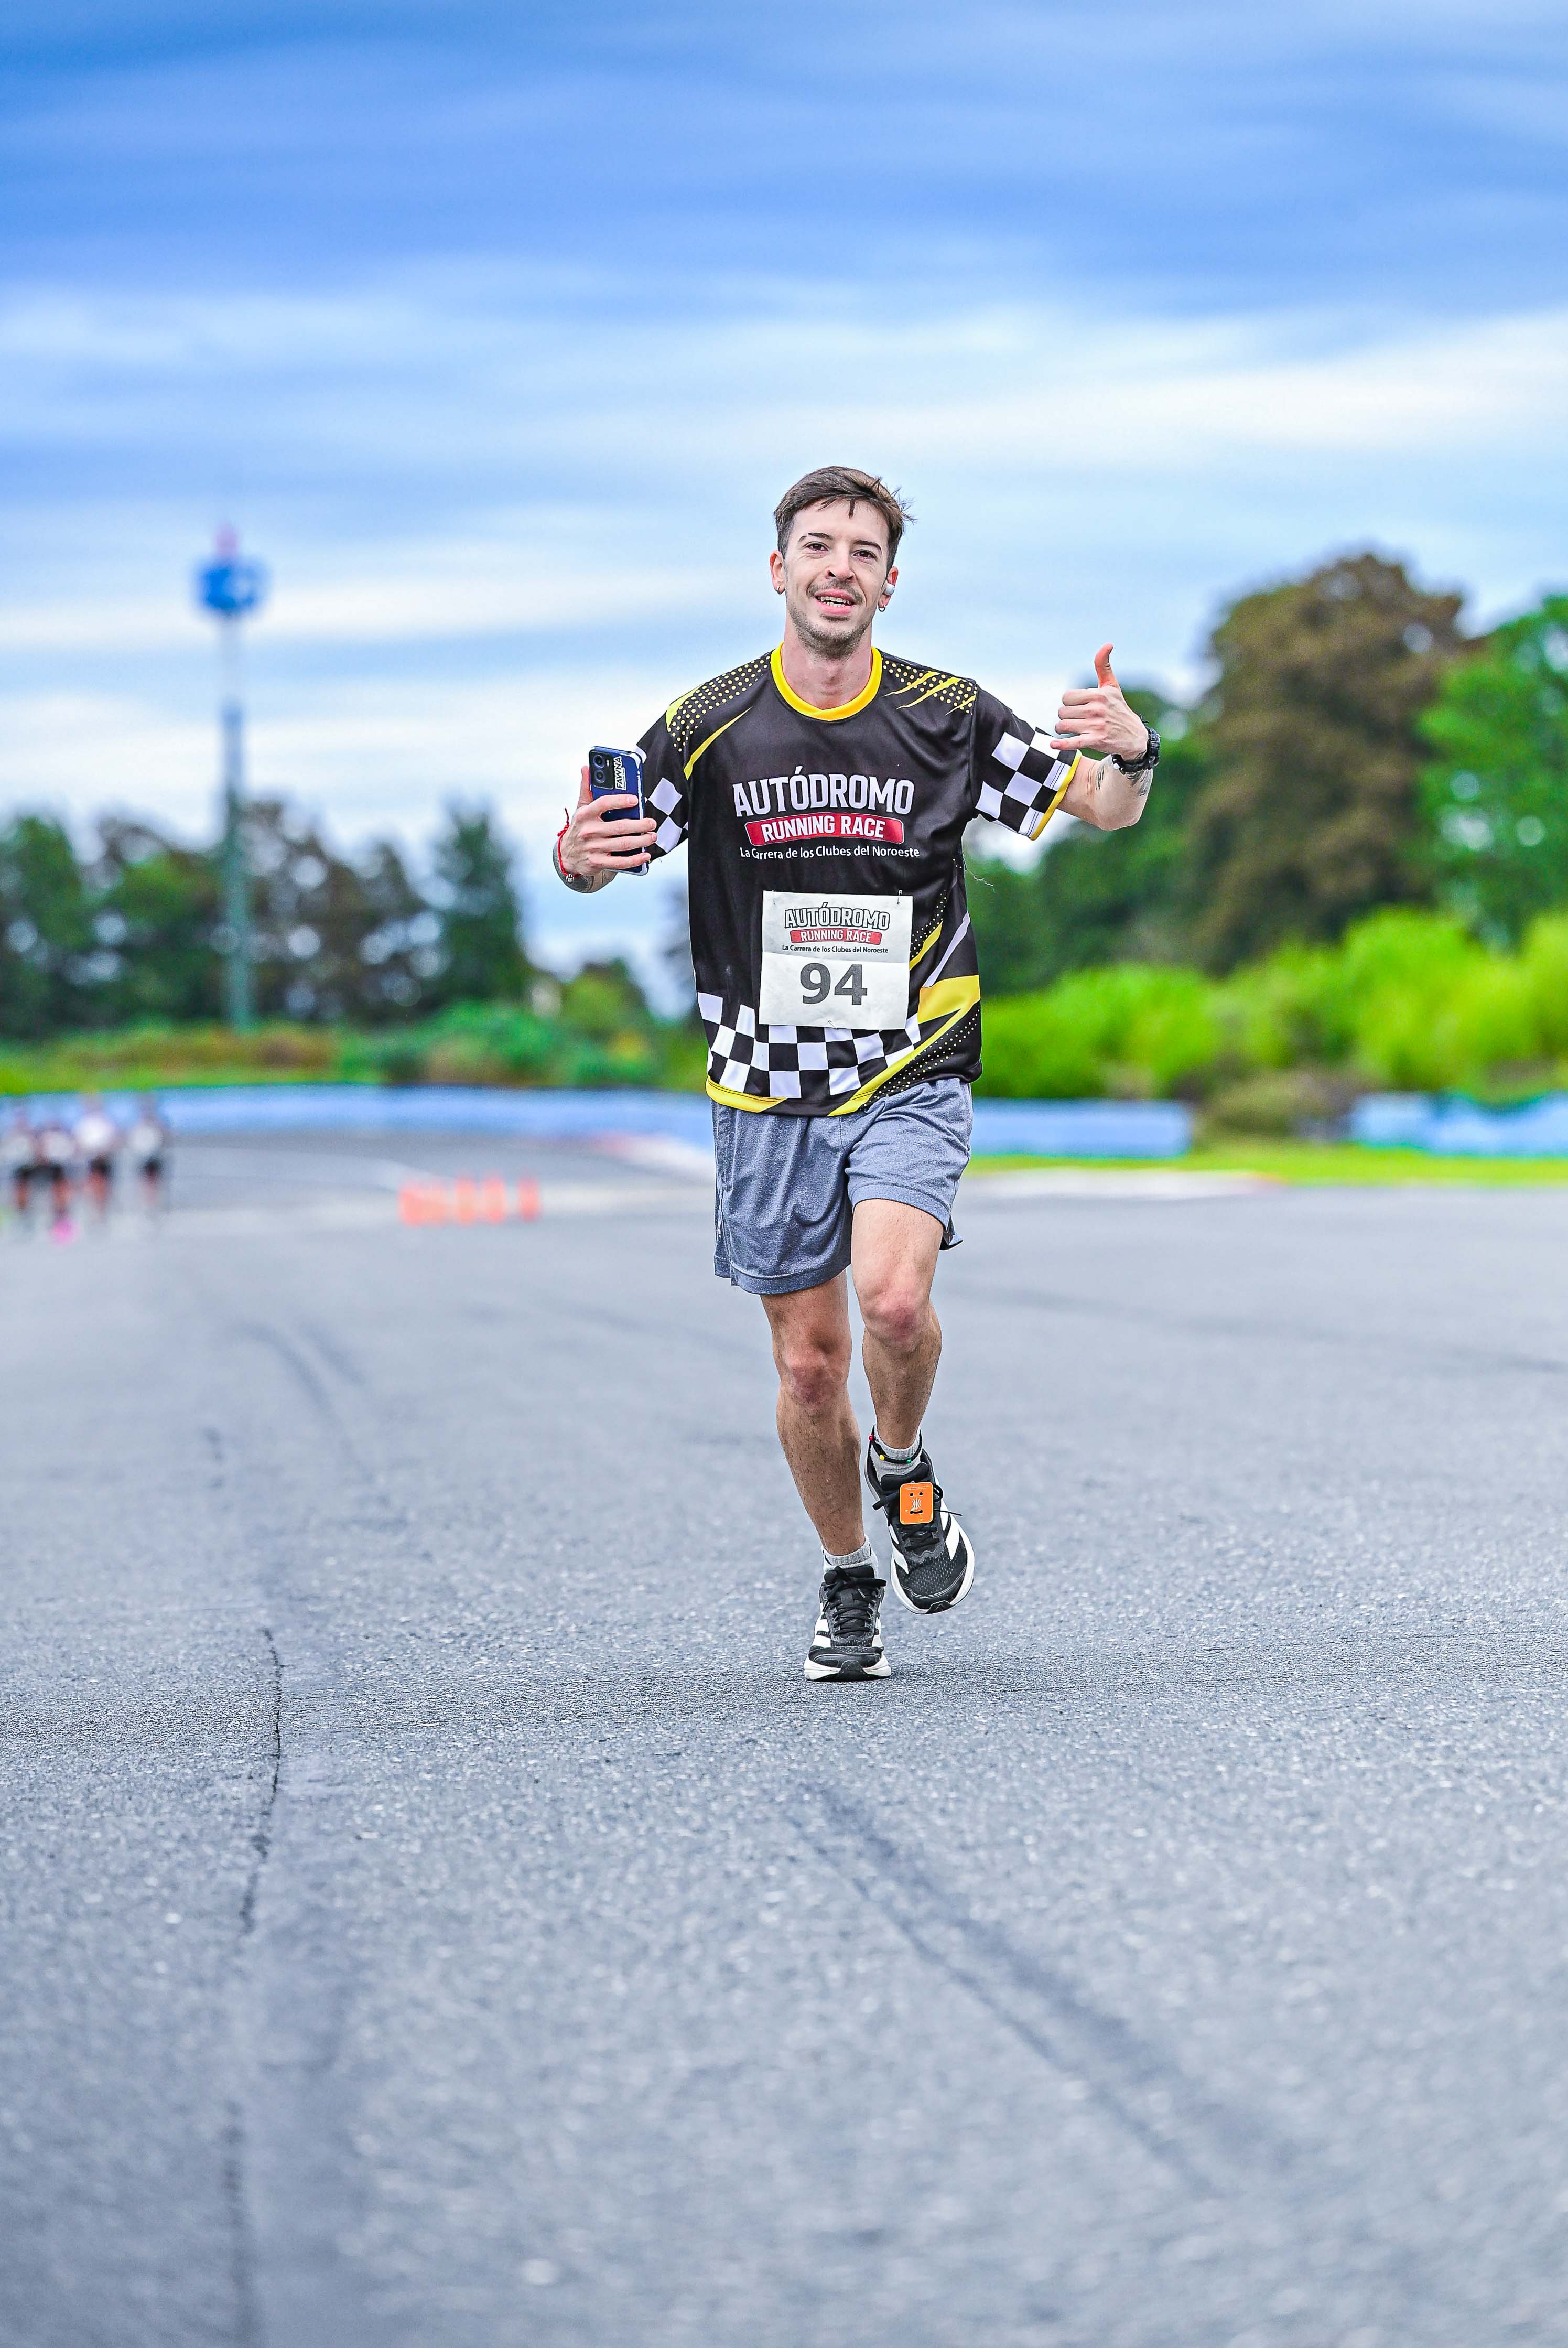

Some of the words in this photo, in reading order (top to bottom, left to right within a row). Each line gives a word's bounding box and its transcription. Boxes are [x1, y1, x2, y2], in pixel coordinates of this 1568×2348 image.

[614, 757, 623, 789] FAWNA
[732, 766, 914, 817] AUTÓDROMO
[761, 815, 836, 842] RUNNING
[840, 815, 886, 838] RACE
[740, 847, 751, 857] La
[751, 848, 783, 860] Carrera
[785, 848, 798, 859] de
[801, 847, 814, 858] los
[816, 845, 851, 857] Clubes
[853, 845, 869, 856] del
[872, 845, 920, 857] Noroeste
[784, 902, 890, 931] AUTÓDROMO
[800, 929, 844, 942] RUNNING
[846, 930, 872, 943] RACE
[800, 963, 868, 1006] 94
